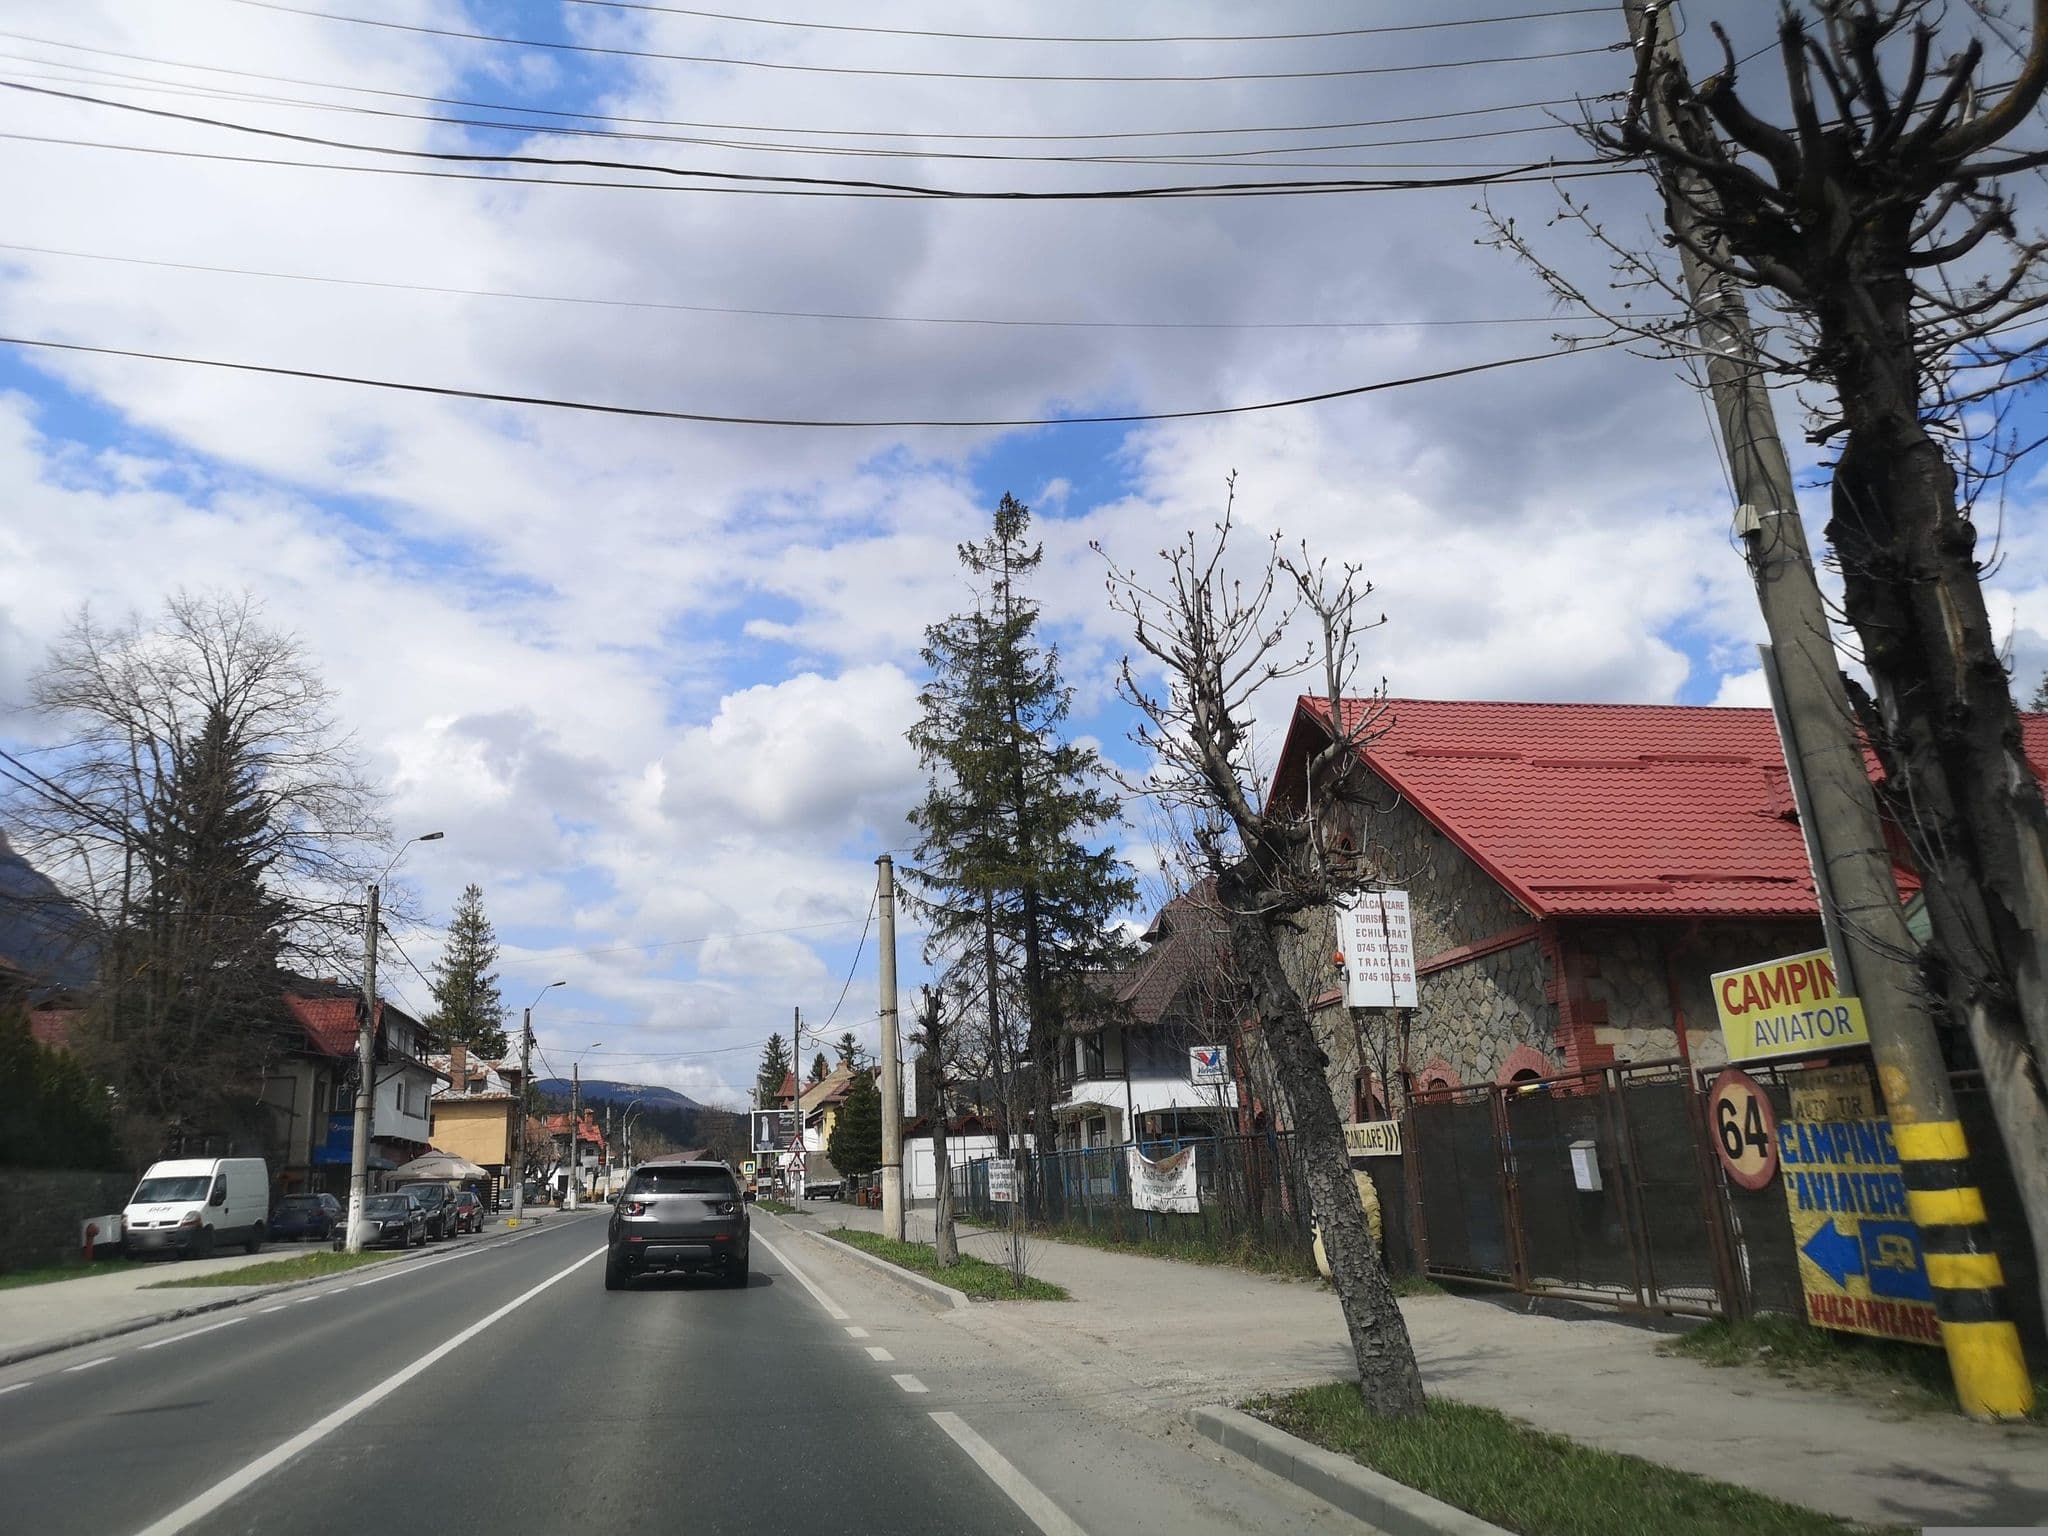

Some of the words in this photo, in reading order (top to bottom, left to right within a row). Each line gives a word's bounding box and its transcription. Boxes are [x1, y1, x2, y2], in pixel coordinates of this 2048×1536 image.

[1394, 915, 1406, 925] TIR
[1356, 928, 1407, 939] ECHILBRAT
[1357, 943, 1375, 953] 0745
[1378, 943, 1408, 953] 1025.97
[1360, 972, 1378, 982] 0745
[1755, 1005, 1853, 1047] AVIATOR
[1717, 1095, 1769, 1160] 64
[1777, 1120, 1900, 1165] CAMPING
